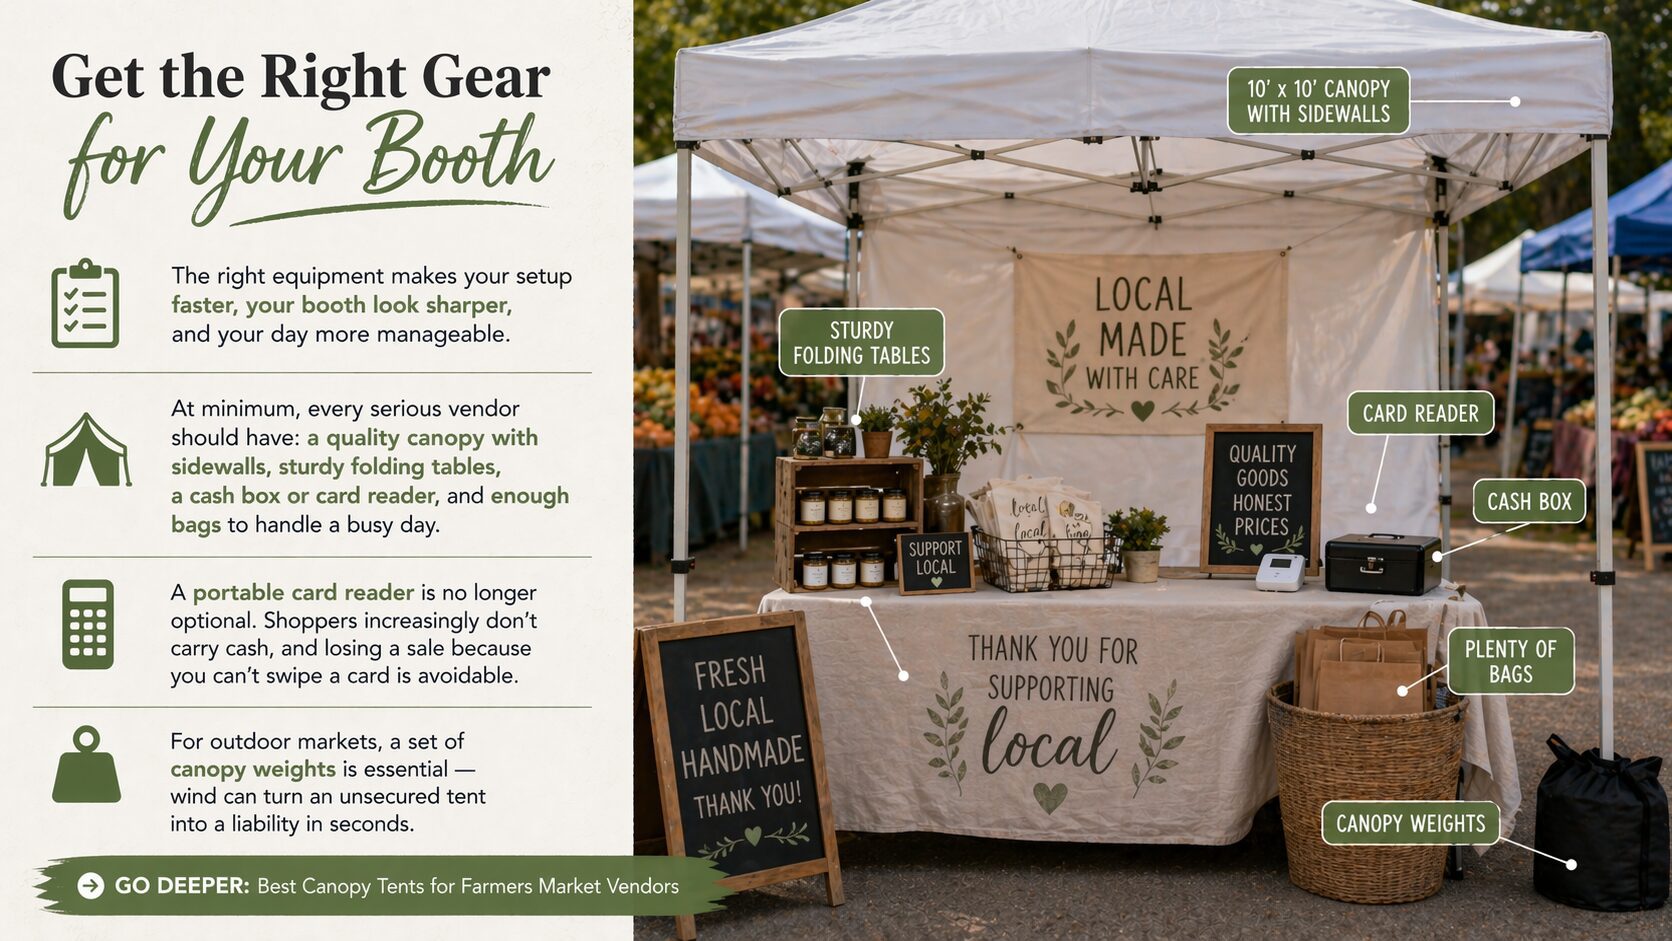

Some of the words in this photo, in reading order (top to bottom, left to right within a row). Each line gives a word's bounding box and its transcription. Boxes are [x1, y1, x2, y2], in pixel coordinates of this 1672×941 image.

[1097, 276, 1192, 311] LOCAL
[1100, 322, 1186, 356] MADE
[1086, 367, 1137, 389] WITH
[1149, 367, 1199, 389] CARE
[1230, 445, 1296, 463] QUALITY
[1237, 469, 1288, 486] GOODS
[1234, 494, 1292, 511] HONEST
[1236, 518, 1288, 535] PRICES
[910, 541, 962, 557] SUPPORT
[917, 559, 956, 575] LOCAL
[969, 635, 1037, 661] THANK
[1049, 635, 1088, 662] YOU
[1100, 637, 1137, 664] FOR
[695, 655, 765, 690] FRESH
[988, 675, 1113, 702] SUPPORTING
[701, 697, 773, 732] LOCAL
[982, 705, 1119, 776] local
[682, 735, 804, 779] HANDMADE
[694, 788, 755, 818] THANK
[761, 780, 801, 808] YOU!
